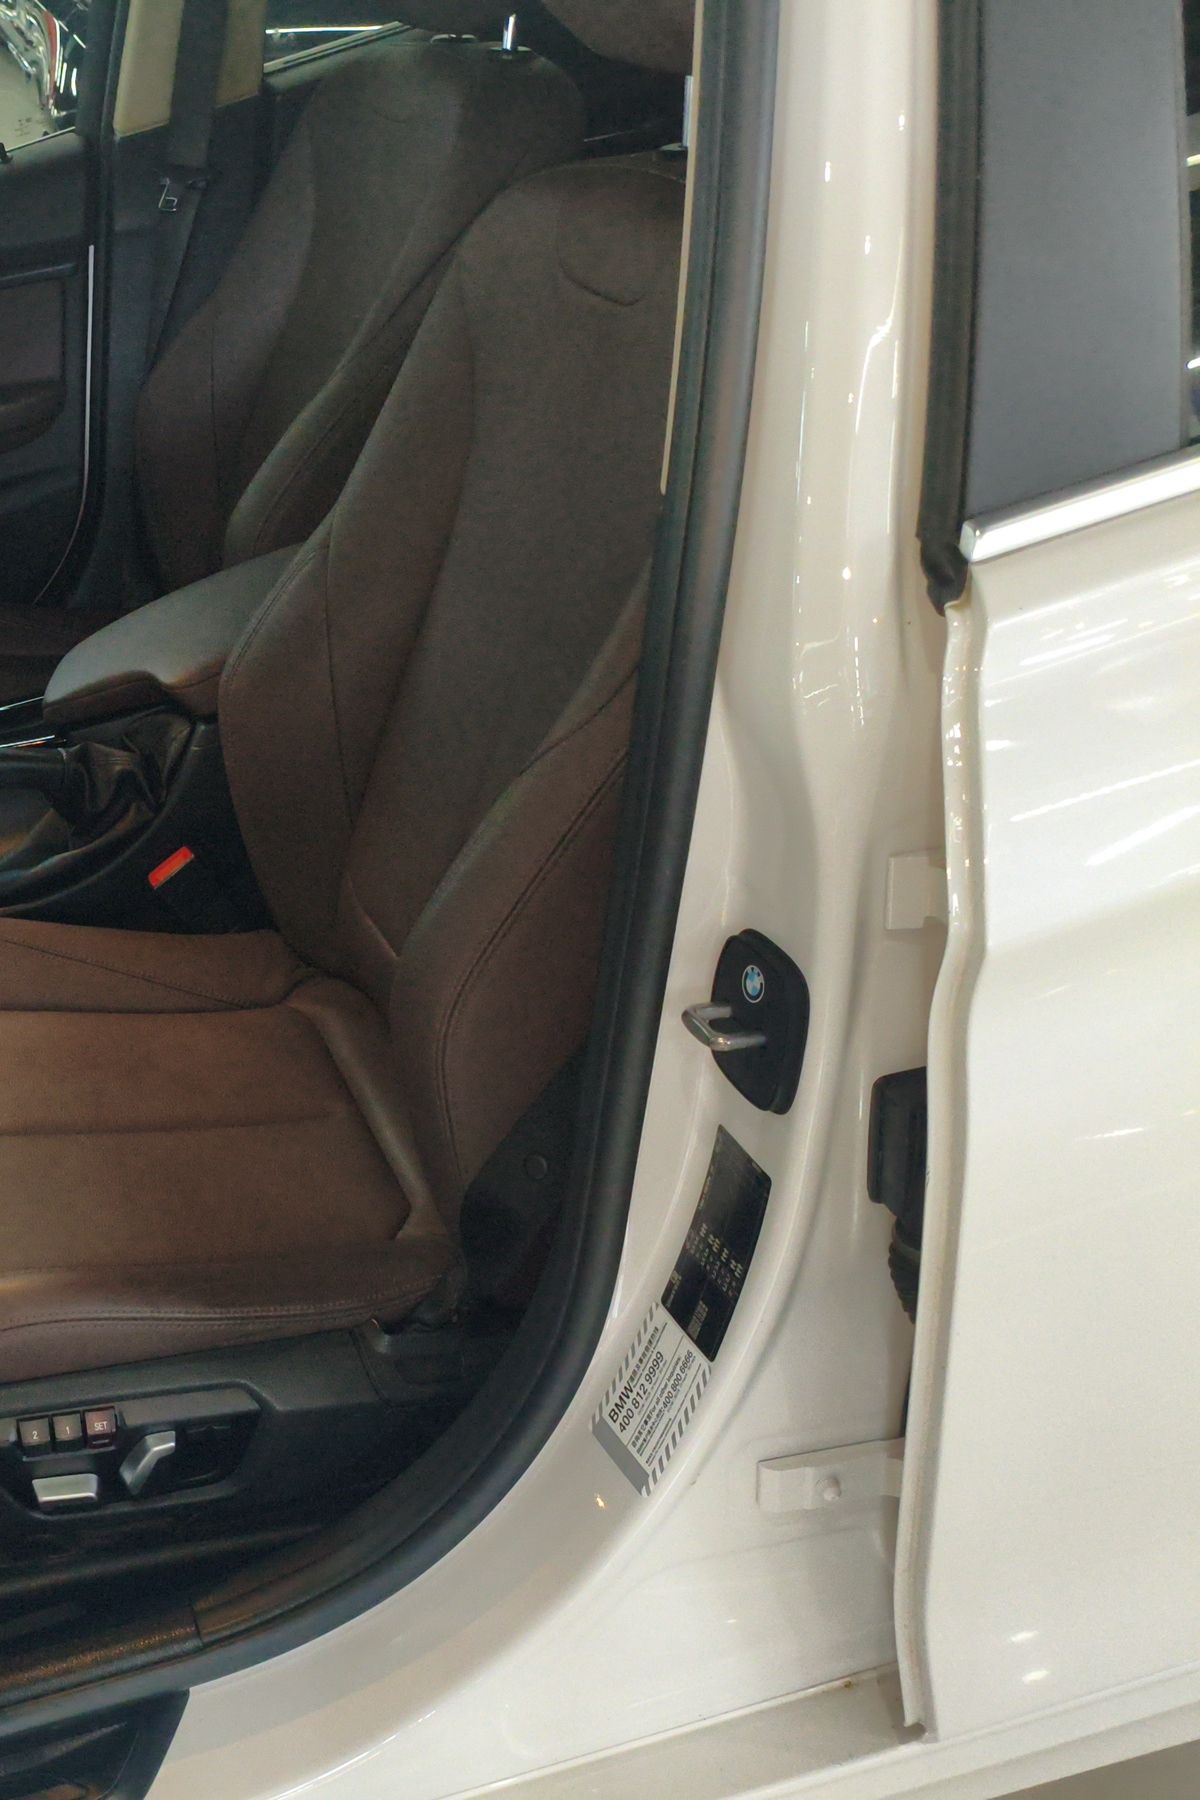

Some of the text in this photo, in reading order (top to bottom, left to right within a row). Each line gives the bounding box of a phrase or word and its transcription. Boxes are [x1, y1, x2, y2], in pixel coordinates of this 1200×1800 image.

[618, 1406, 635, 1434] 400
[630, 1382, 648, 1410] 812
[644, 1350, 664, 1386] 9999
[670, 1372, 683, 1393] 800
[678, 1349, 694, 1375] 6666
[608, 1380, 634, 1424] BMW
[32, 1430, 38, 1440] 2
[94, 1421, 108, 1432] SET
